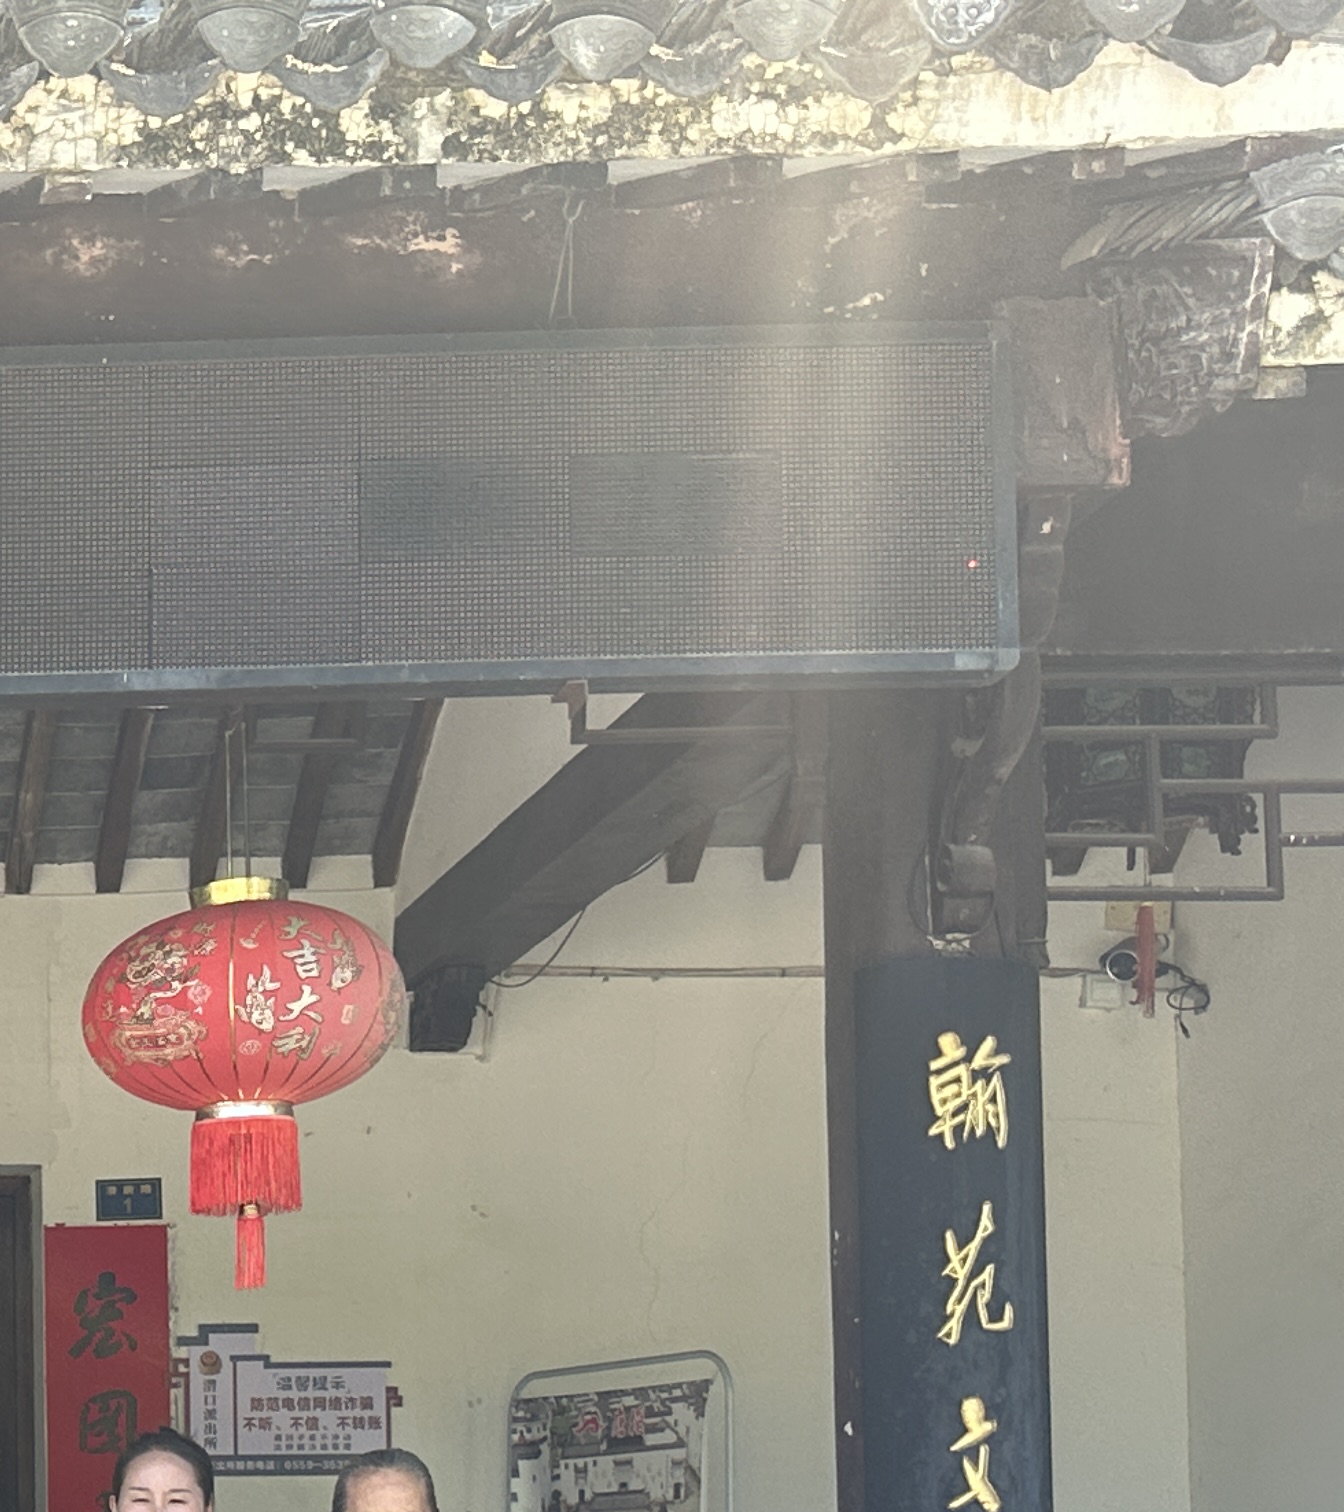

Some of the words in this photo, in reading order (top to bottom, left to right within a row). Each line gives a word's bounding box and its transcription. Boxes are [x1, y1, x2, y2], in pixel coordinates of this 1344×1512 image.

[272, 916, 327, 1060] 大吉大利
[250, 1396, 374, 1412] 防范电信网络诈骗
